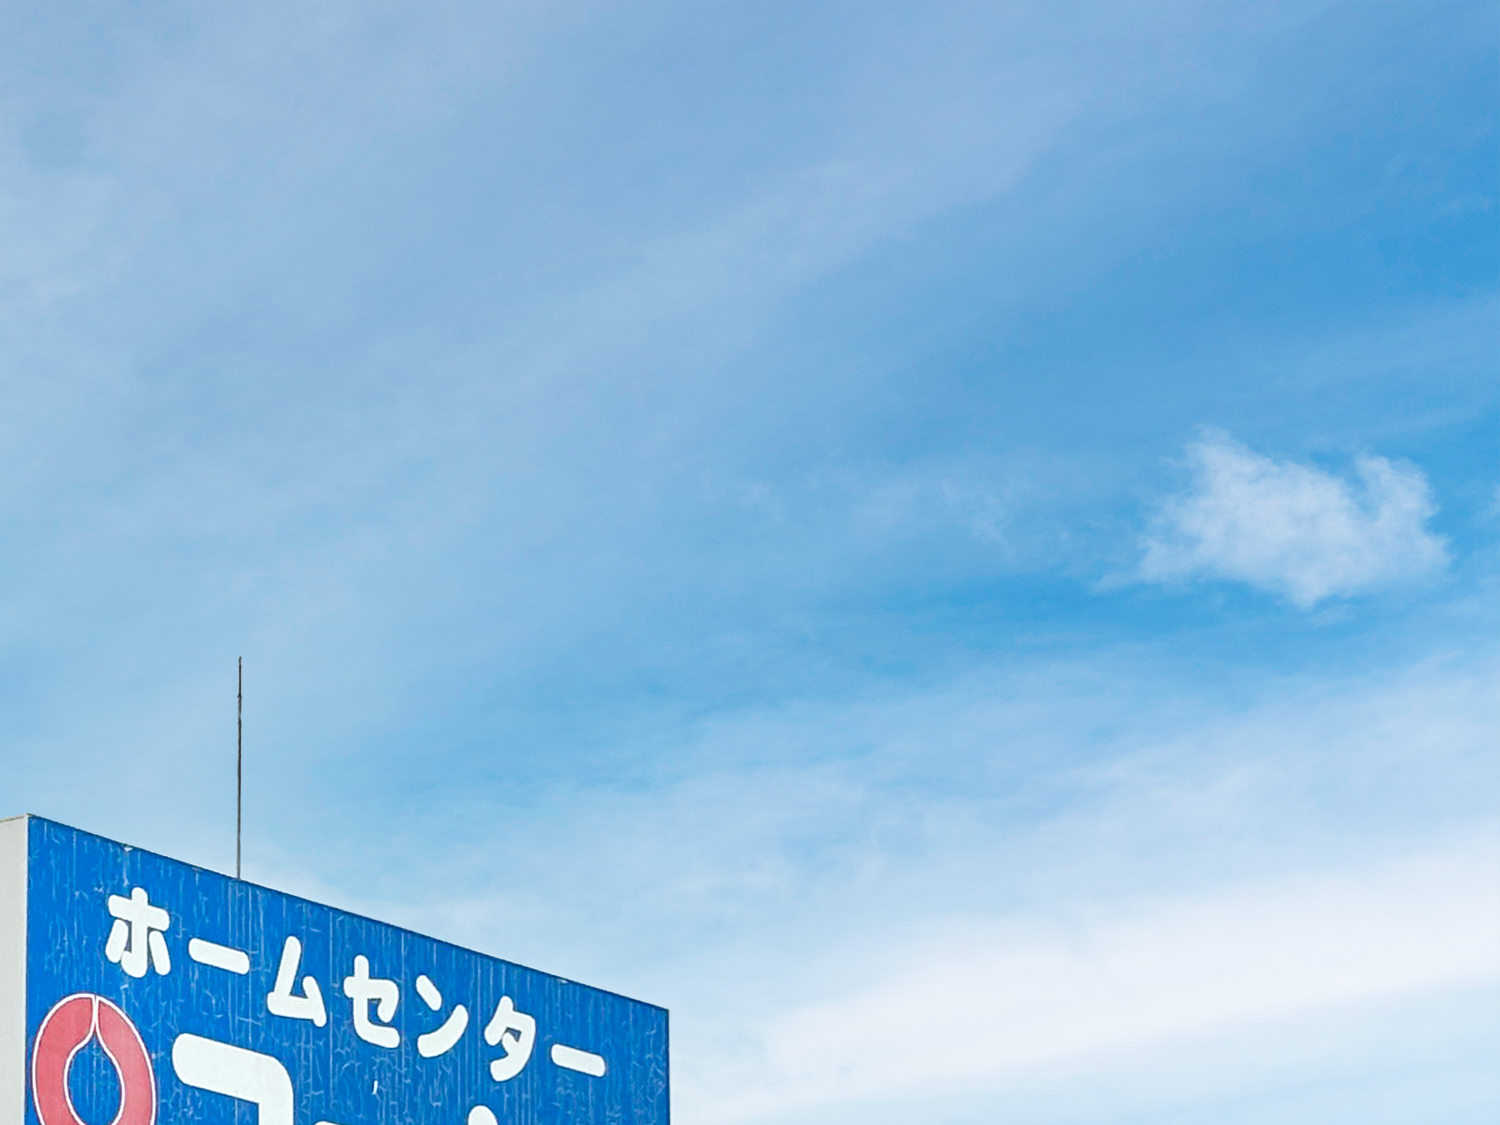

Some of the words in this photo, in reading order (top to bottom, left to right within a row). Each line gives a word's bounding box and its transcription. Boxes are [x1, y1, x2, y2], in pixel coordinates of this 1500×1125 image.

[105, 886, 607, 1082] ホームセンター
